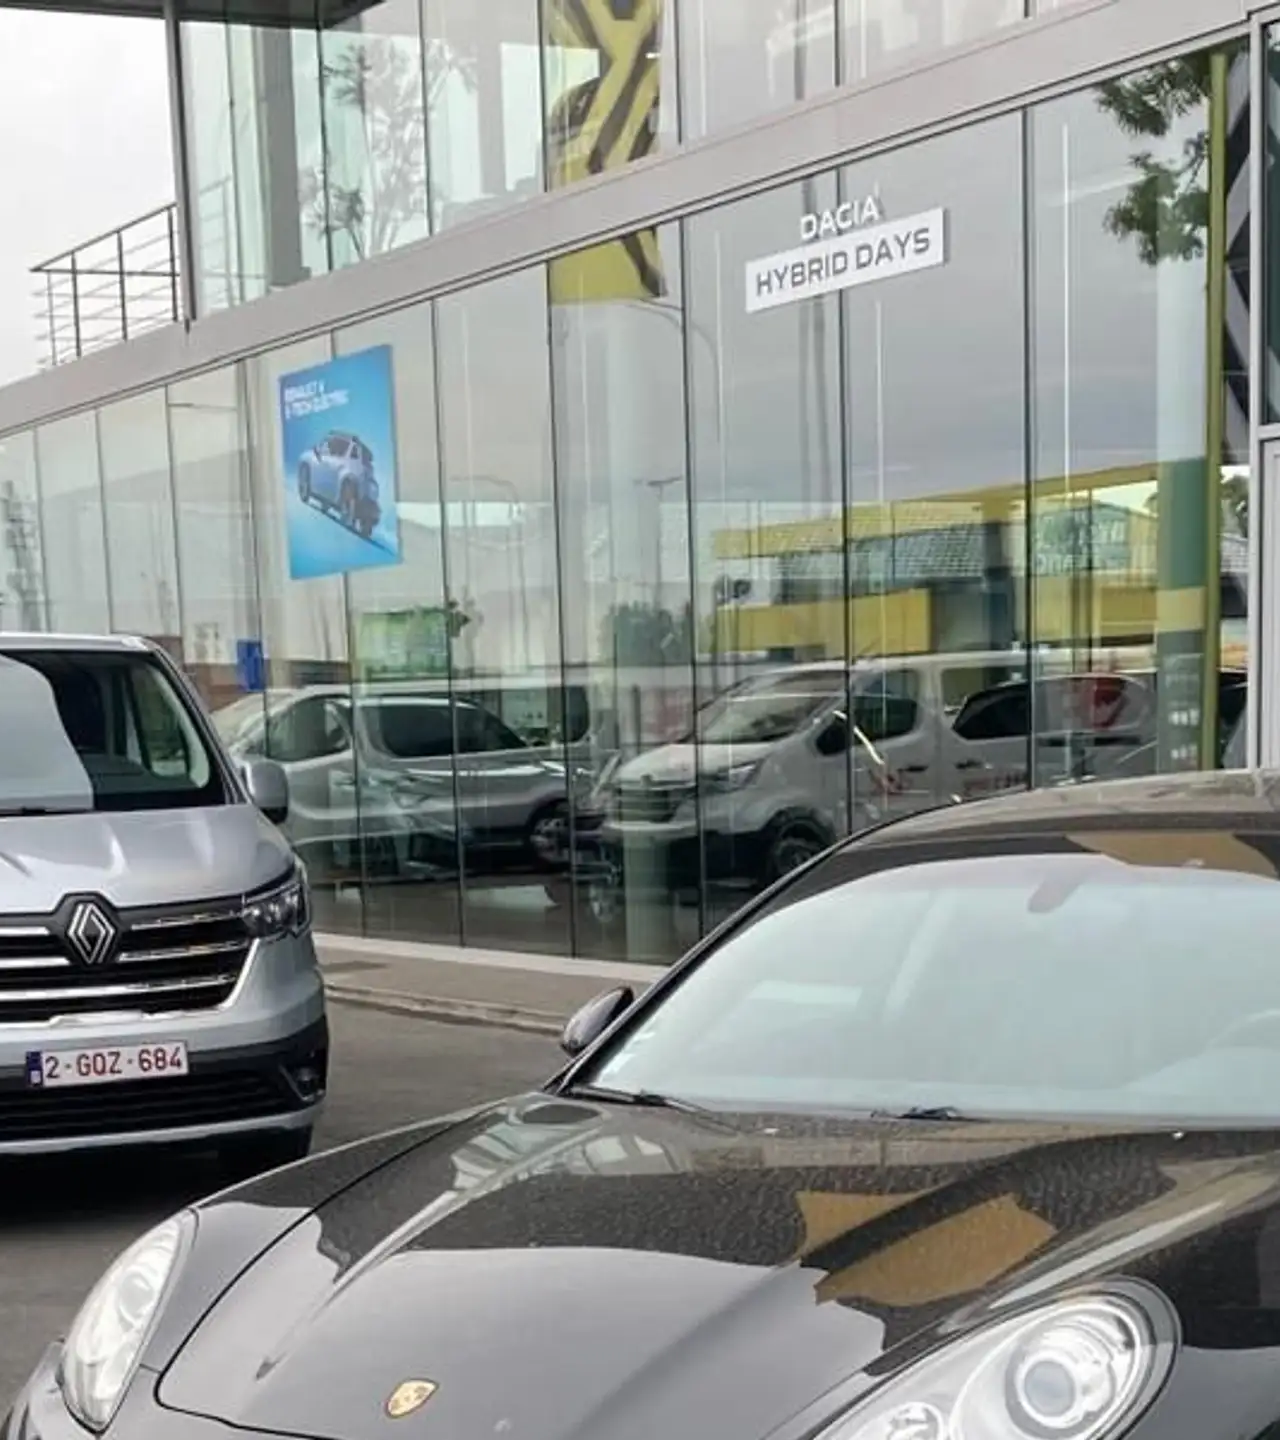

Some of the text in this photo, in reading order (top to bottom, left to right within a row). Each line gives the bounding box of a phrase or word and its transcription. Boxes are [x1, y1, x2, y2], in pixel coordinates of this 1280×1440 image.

[801, 196, 879, 239] DACIA
[756, 228, 930, 296] HYBRID DAYS
